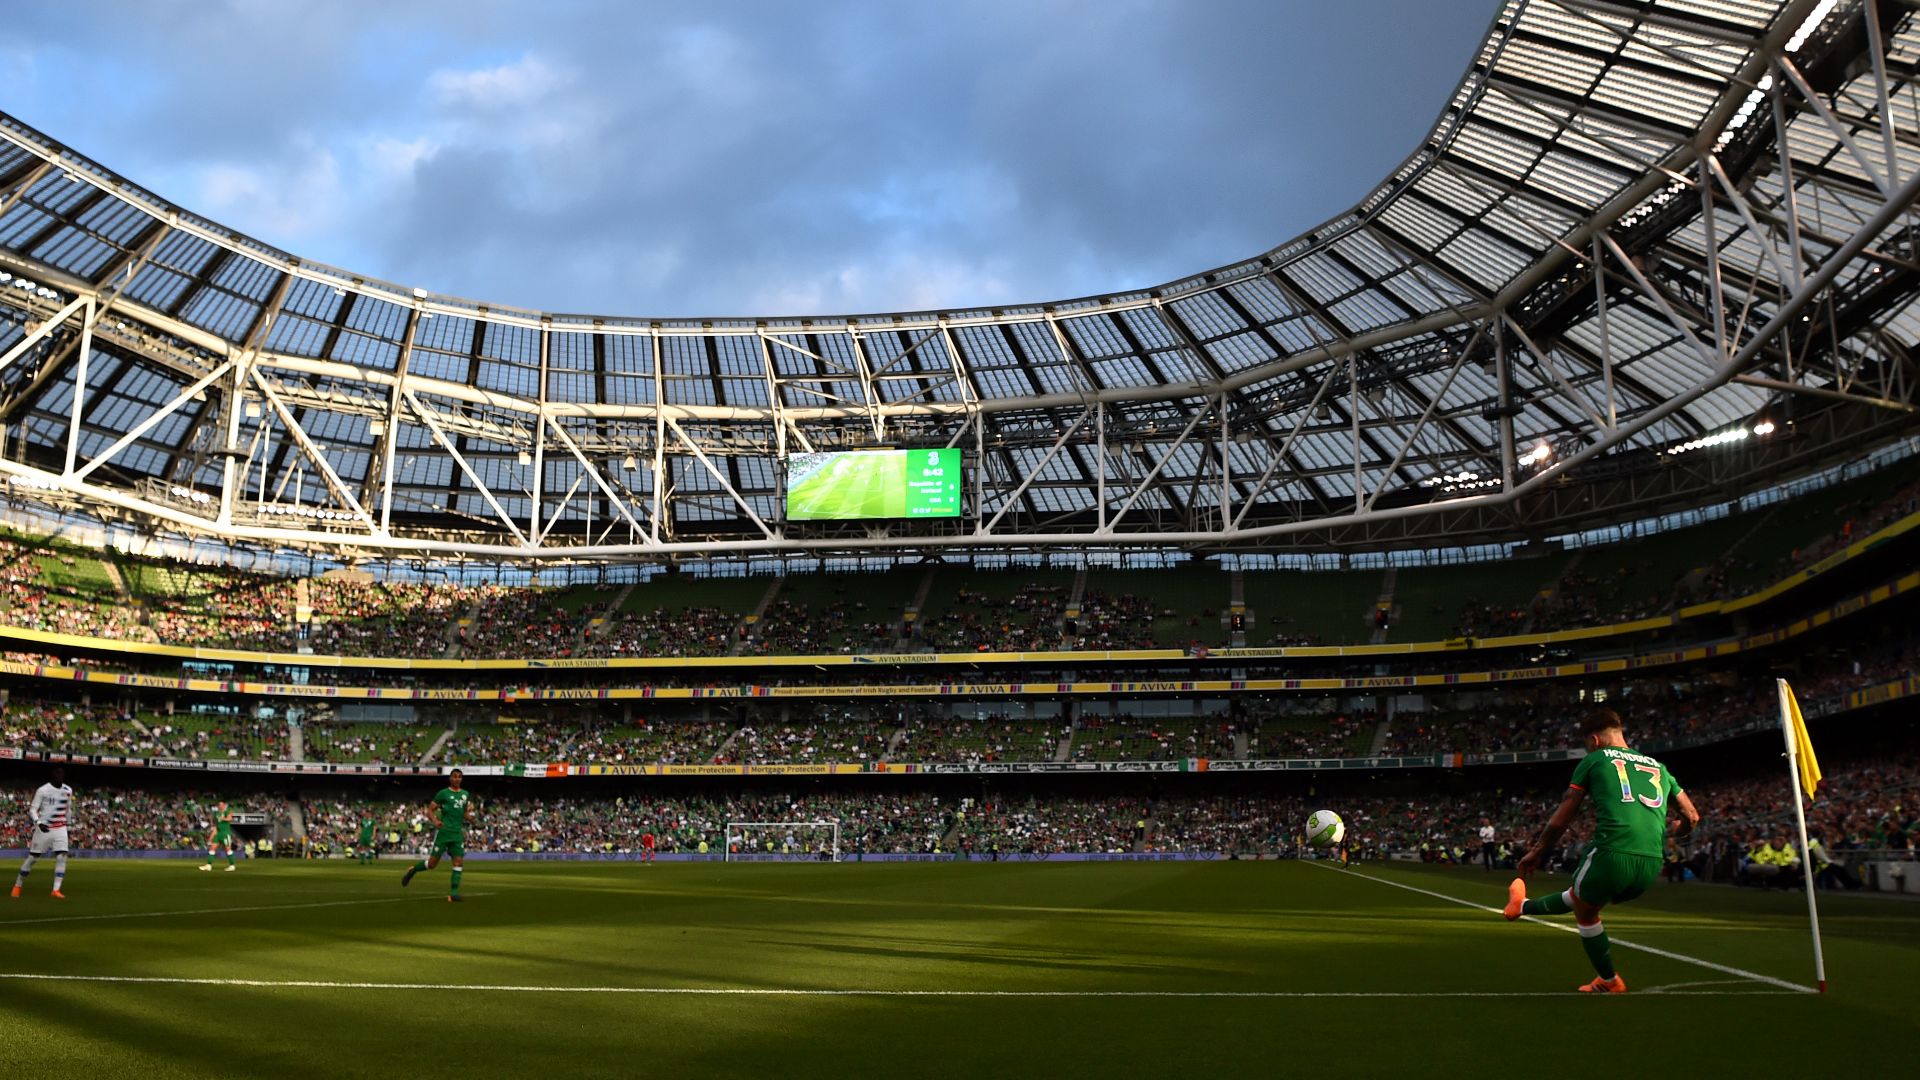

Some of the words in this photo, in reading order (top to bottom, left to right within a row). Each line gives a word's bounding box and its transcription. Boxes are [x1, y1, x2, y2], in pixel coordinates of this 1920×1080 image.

[1222, 649, 1244, 657] AVIVA
[1249, 648, 1282, 656] STADIUM
[1512, 670, 1545, 679] AVIVA
[143, 678, 175, 688] AVIVA
[1140, 682, 1176, 691] AVIVA
[1368, 678, 1401, 687] AVIVA
[290, 687, 323, 695] AVIVA
[969, 685, 1005, 693] AVIVA
[434, 691, 464, 699] AVIVA
[560, 690, 593, 698] AVIVA
[612, 766, 647, 775] AVIVA
[751, 766, 785, 775] Mortgage
[1611, 758, 1664, 808] 13
